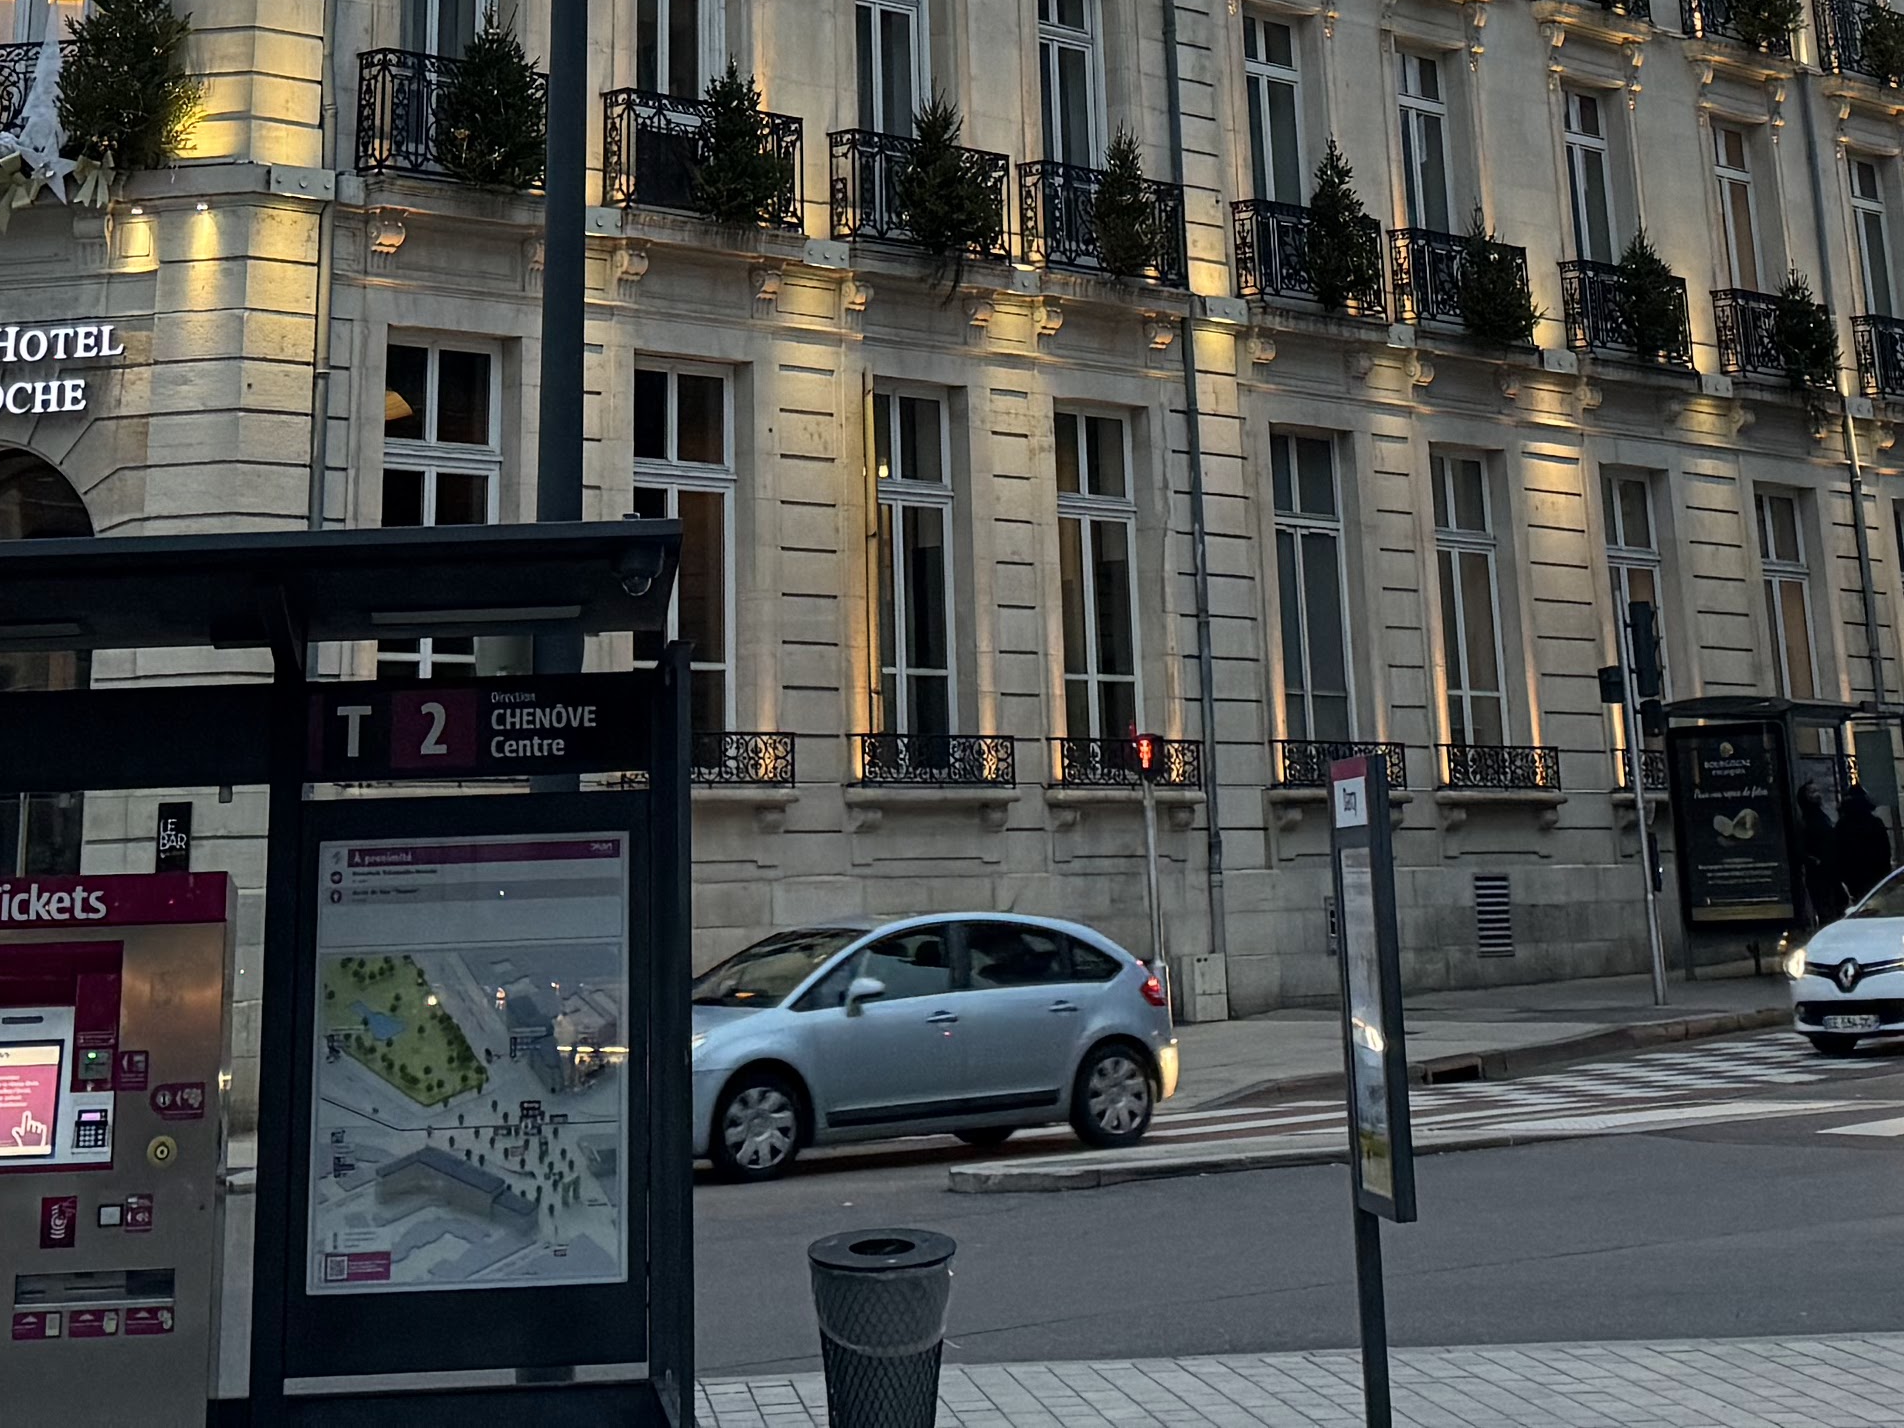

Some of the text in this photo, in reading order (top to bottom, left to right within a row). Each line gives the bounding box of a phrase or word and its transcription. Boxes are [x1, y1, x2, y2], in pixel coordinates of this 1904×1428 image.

[337, 701, 597, 758] T 2 CHENÔVE
[490, 735, 566, 759] Centre
[160, 818, 178, 835] LE
[159, 833, 187, 850] BAR
